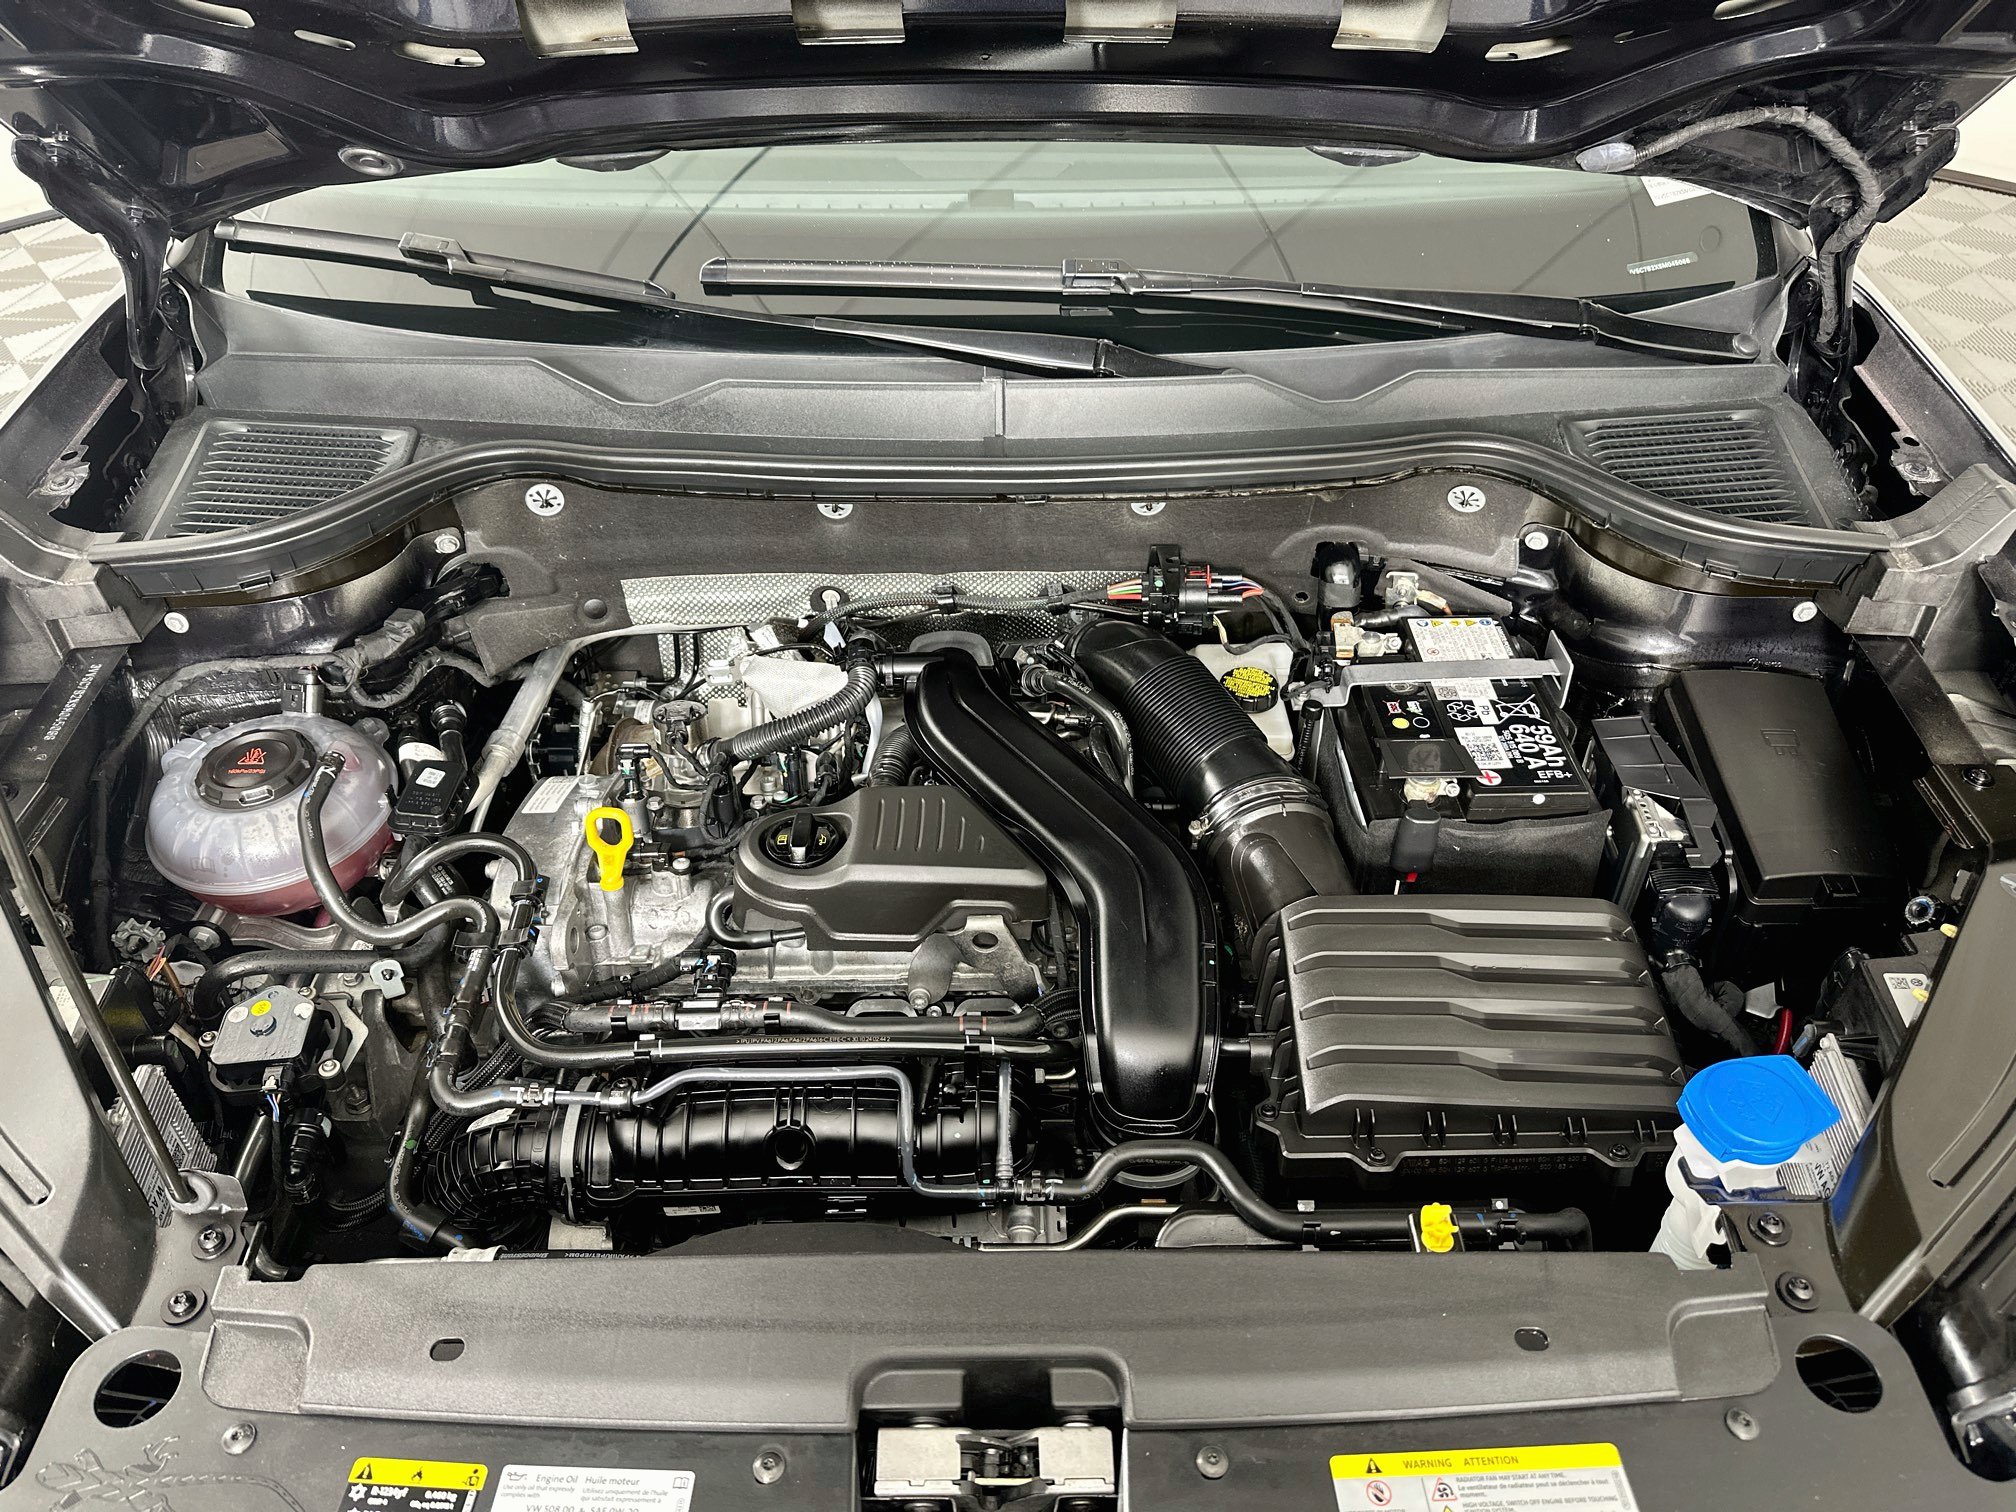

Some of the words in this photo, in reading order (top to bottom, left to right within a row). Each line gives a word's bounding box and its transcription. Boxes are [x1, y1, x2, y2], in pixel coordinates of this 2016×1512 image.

[1508, 723, 1541, 753] 640
[1529, 724, 1567, 768] 59Ah
[1523, 755, 1548, 770] A
[1536, 769, 1573, 779] EFB+
[1402, 1458, 1453, 1469] WARNING
[1464, 1455, 1519, 1467] ATTENTION
[536, 1474, 564, 1485] Engine
[566, 1475, 578, 1484] Oil
[584, 1476, 607, 1485] Huile
[608, 1478, 640, 1486] moteur
